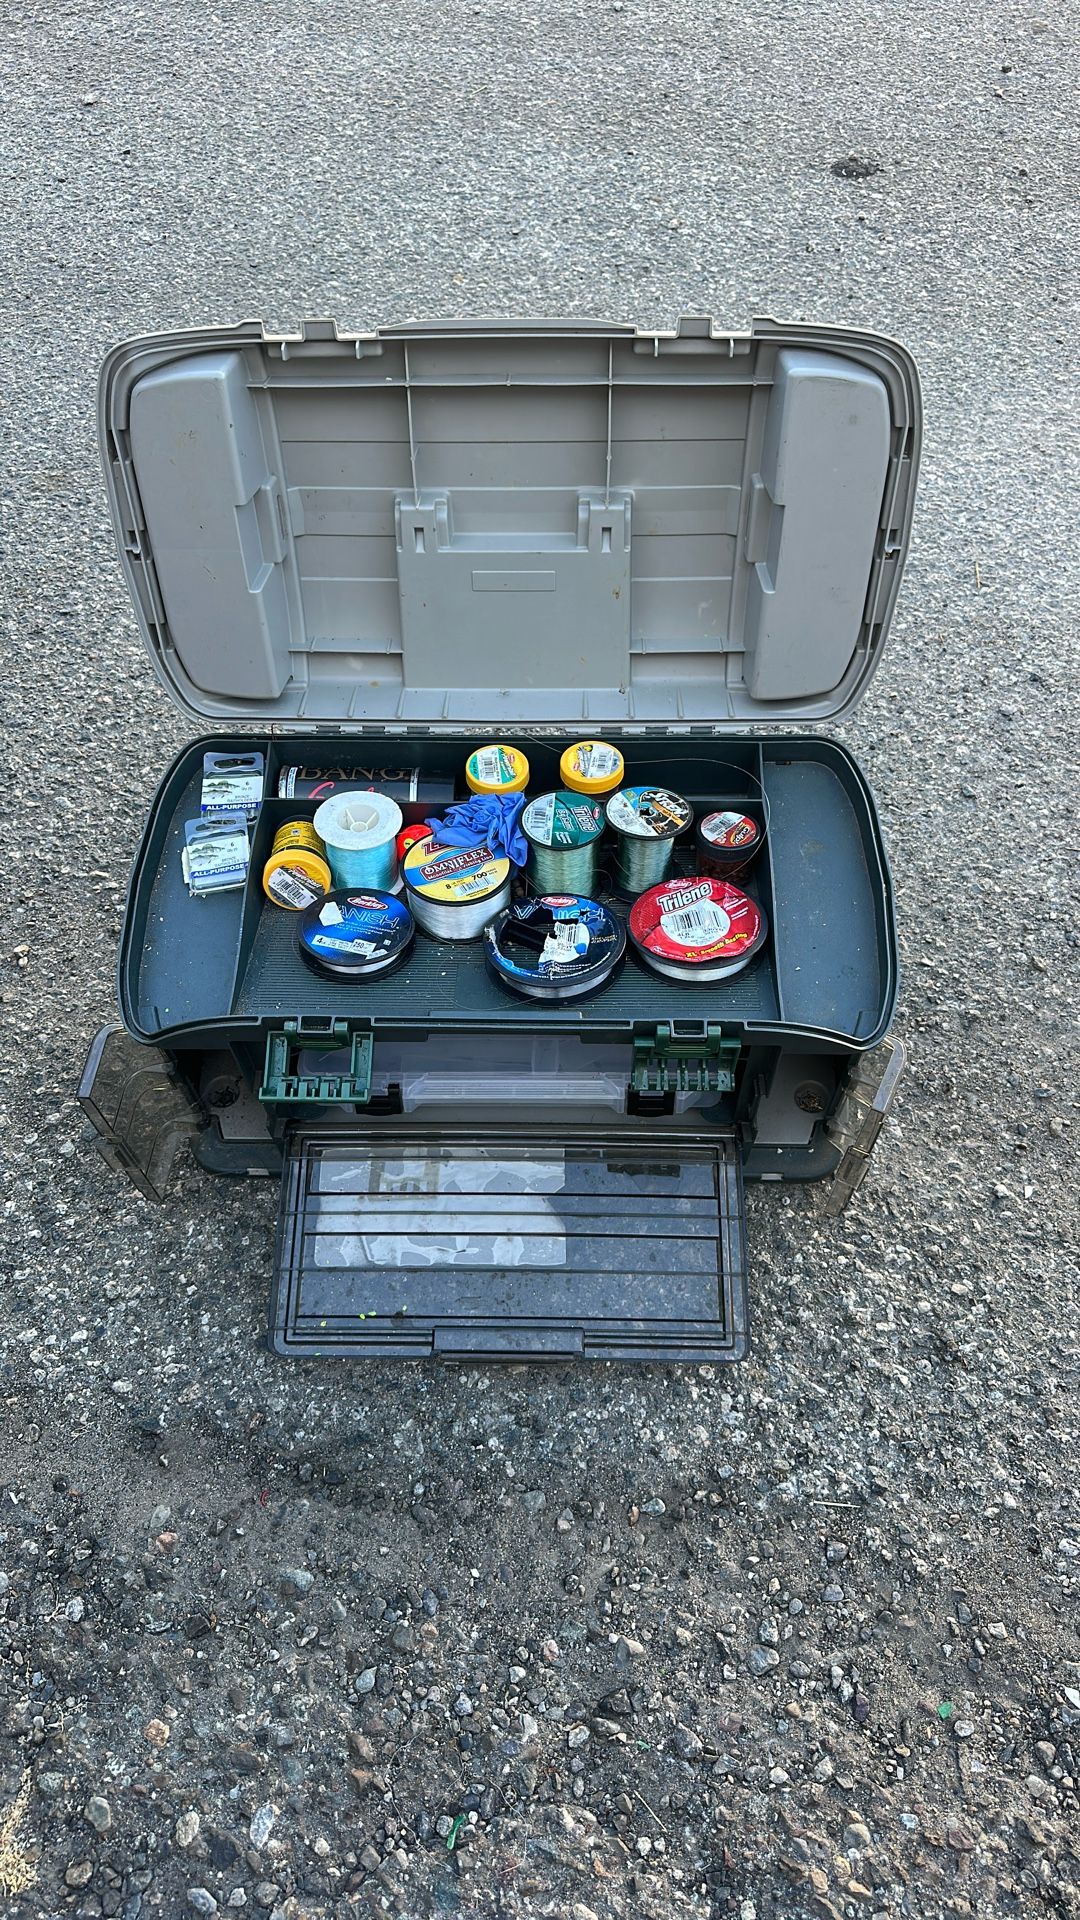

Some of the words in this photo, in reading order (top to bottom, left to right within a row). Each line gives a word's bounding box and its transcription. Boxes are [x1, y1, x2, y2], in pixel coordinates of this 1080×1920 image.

[206, 802, 257, 811] ALL-PURPOSE
[193, 863, 244, 877] ALL-PURPOSE
[424, 848, 488, 876] OMNIFLEX
[471, 871, 488, 881] 700
[659, 883, 711, 912] Trilene
[340, 905, 400, 928] ANISH
